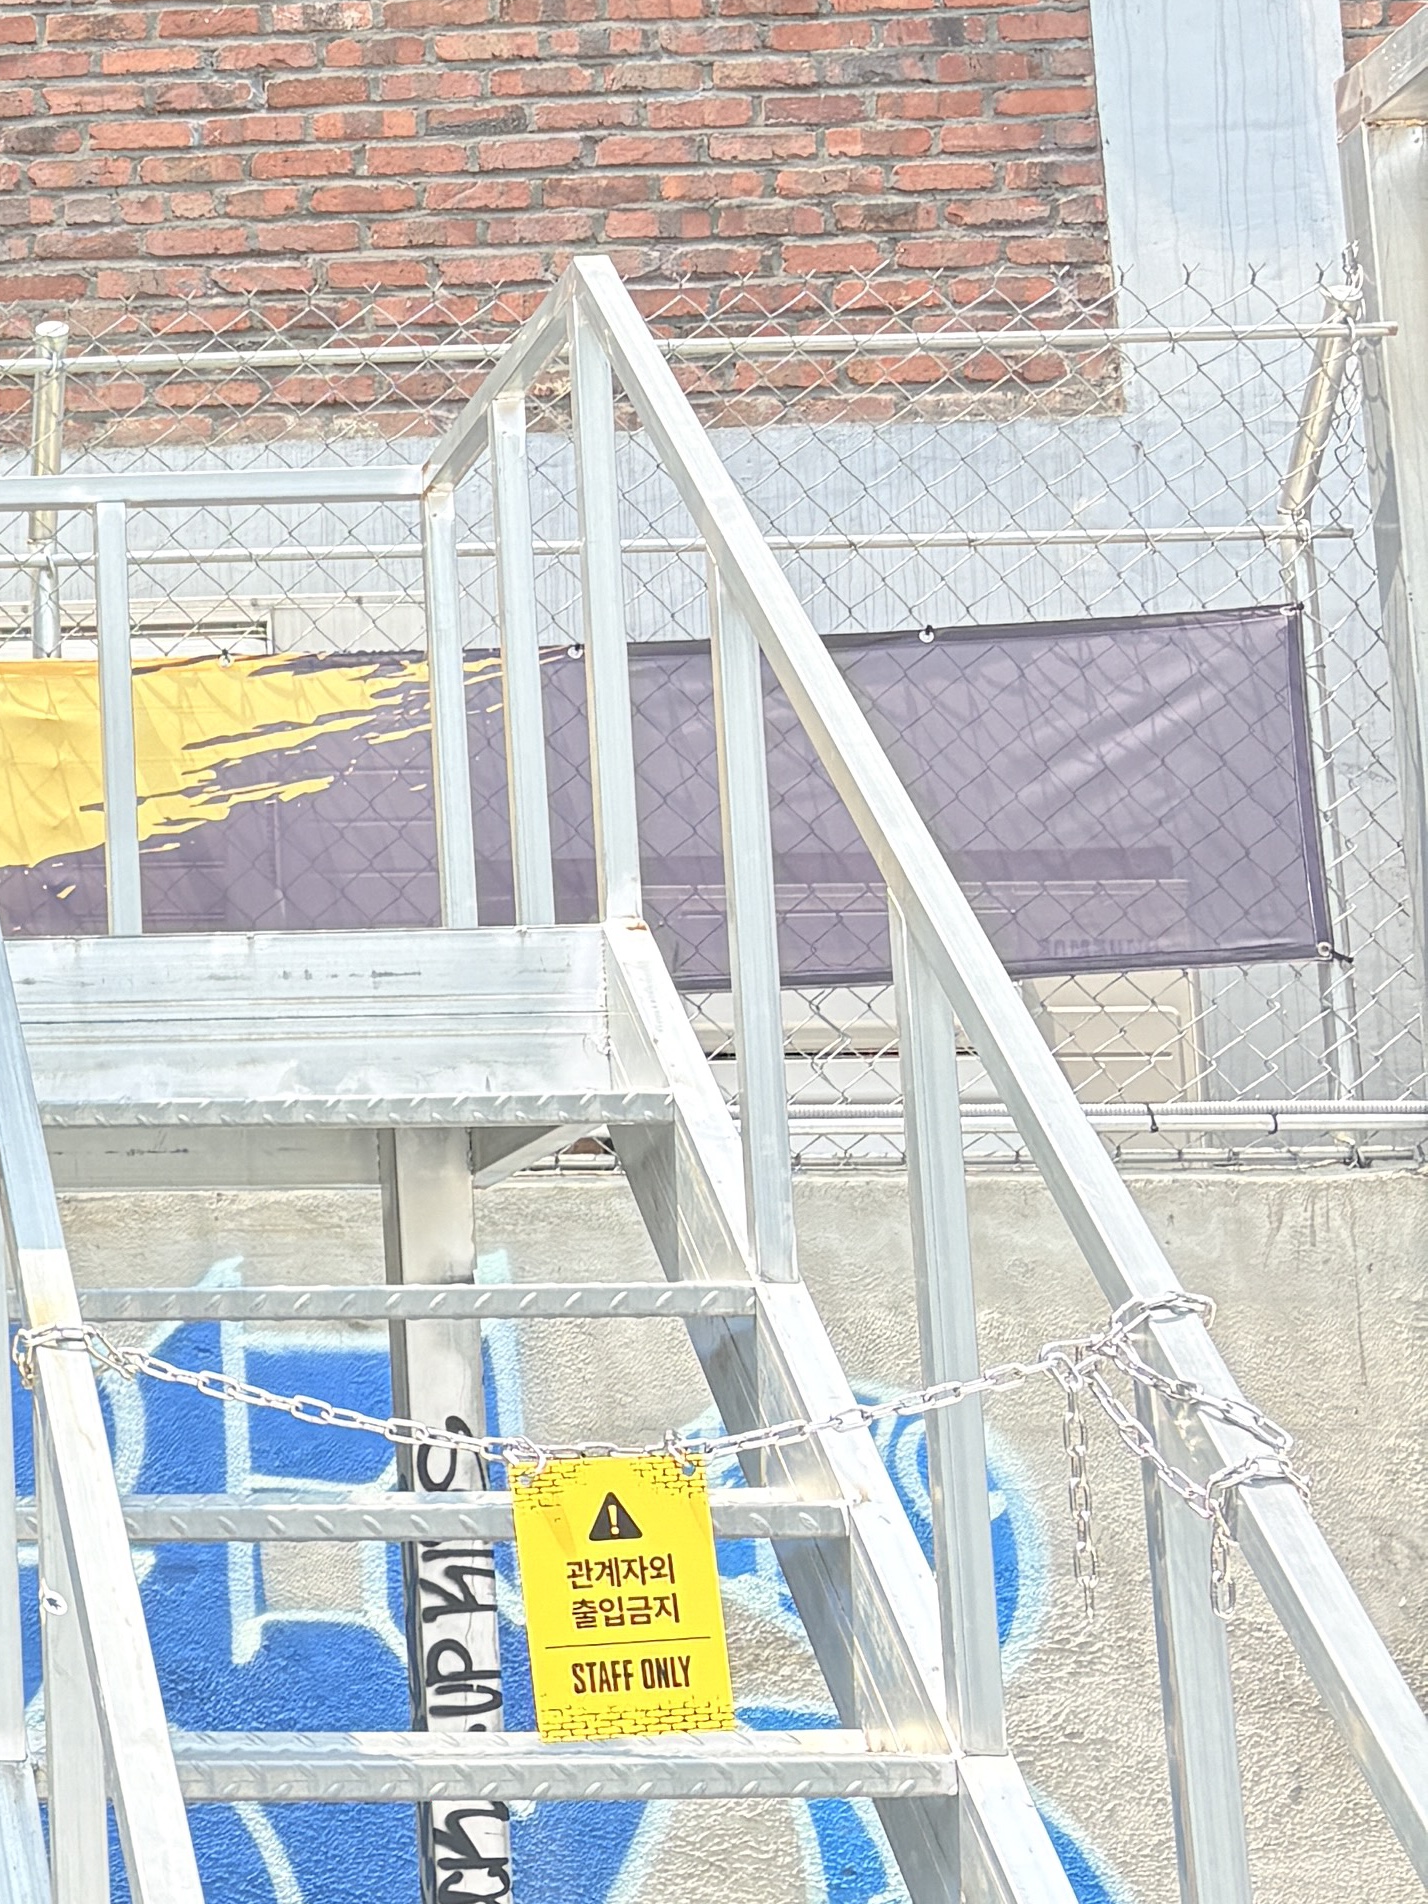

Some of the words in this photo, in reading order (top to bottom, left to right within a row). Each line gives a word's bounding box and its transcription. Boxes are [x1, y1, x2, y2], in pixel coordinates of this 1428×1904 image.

[565, 1552, 676, 1589] 관계자외
[571, 1592, 681, 1629] 출입금지
[571, 1659, 635, 1695] STAFF
[640, 1655, 692, 1690] ONLY
